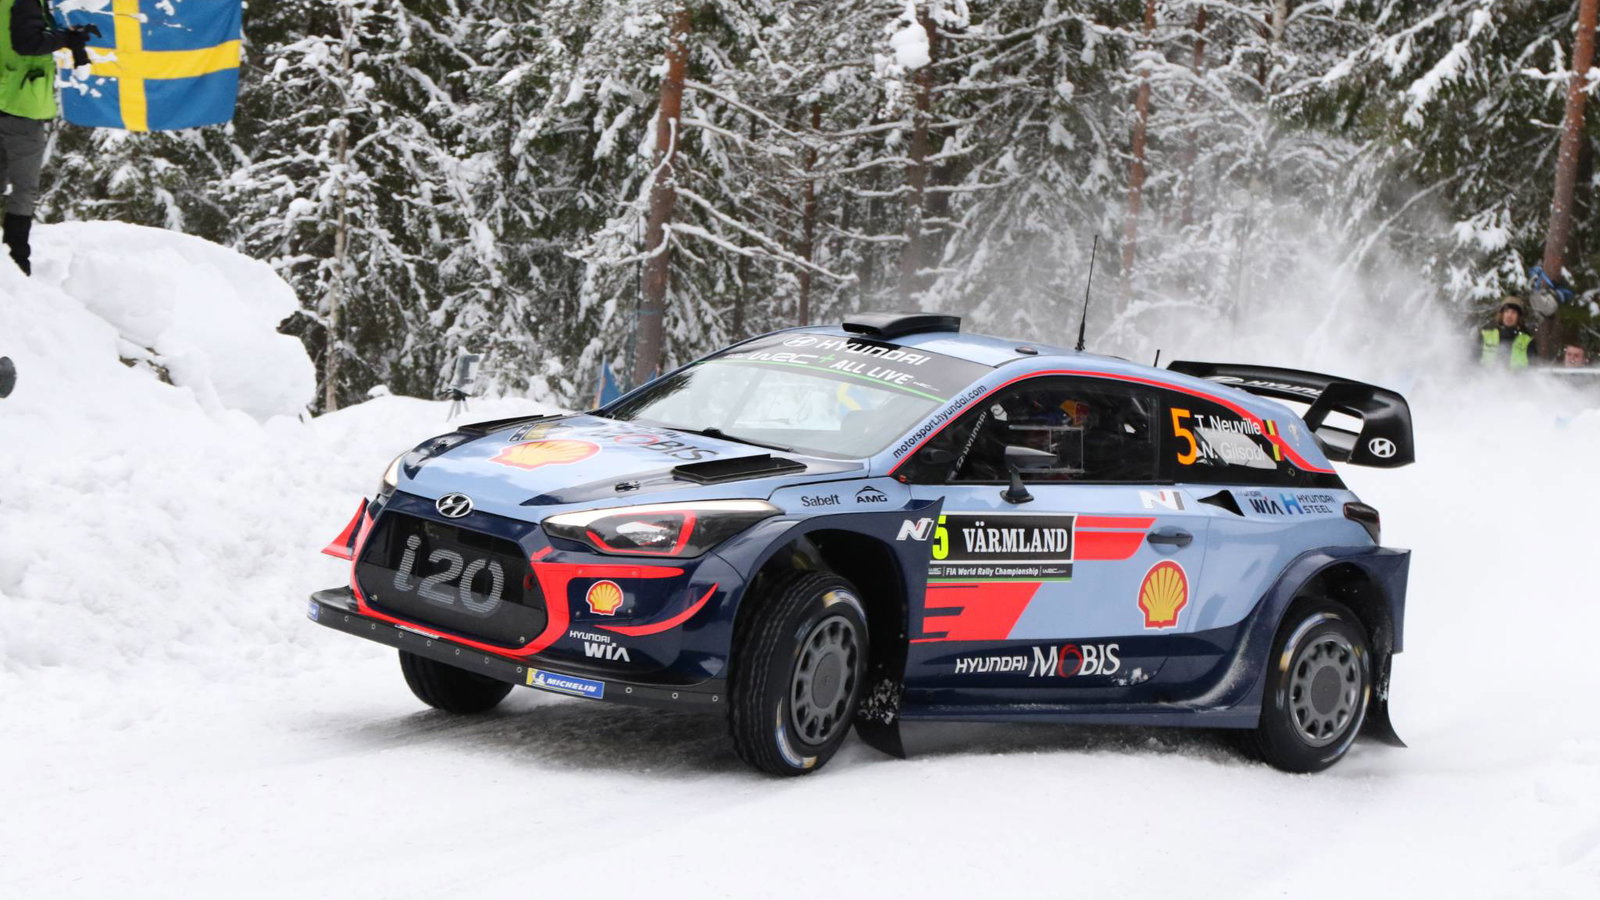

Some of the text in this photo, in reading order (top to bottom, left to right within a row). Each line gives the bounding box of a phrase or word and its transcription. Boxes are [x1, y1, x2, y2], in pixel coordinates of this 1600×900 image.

[816, 339, 931, 365] HYUNDAI
[829, 359, 864, 374] ALL
[867, 367, 914, 385] LIVE
[892, 384, 987, 459] motorsport.hyundai.com
[1170, 407, 1262, 466] 5 T. Neuville
[1202, 442, 1265, 461] N. Gilsoul
[801, 494, 841, 508] Sabelt
[856, 494, 888, 503] AMG
[1296, 495, 1336, 504] HYUNDAI
[1303, 505, 1333, 514] STEEL
[932, 515, 1068, 560] 5 VÄRMLAND
[393, 534, 505, 618] i20
[958, 567, 976, 575] World
[978, 567, 994, 577] Rally
[995, 567, 1039, 577] Championship
[569, 630, 611, 644] HYUNDAI
[955, 644, 1120, 678] HYUNDAI MOBIS
[546, 677, 597, 693] MICHELIN
